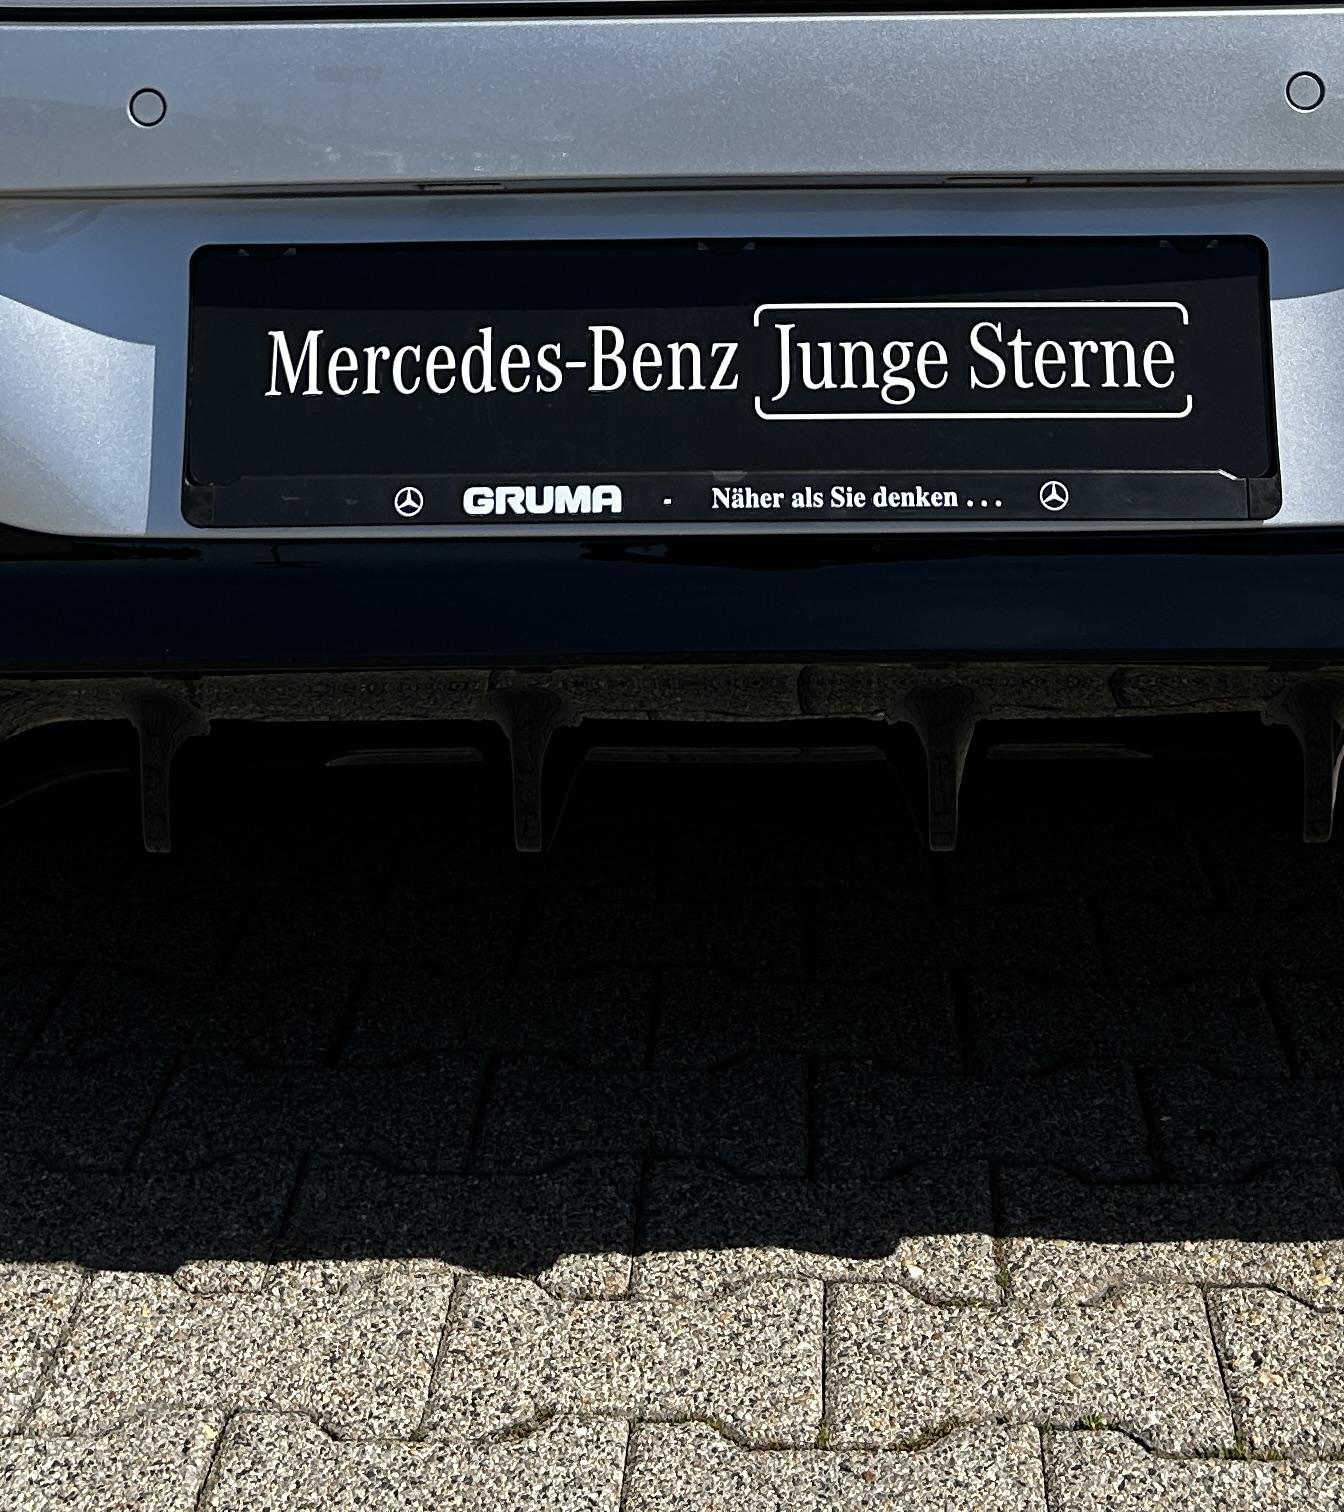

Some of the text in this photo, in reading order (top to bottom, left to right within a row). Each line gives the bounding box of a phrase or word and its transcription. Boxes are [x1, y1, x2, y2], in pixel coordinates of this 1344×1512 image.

[265, 320, 1175, 405] Mercedes-Benz Junge Sterne
[462, 484, 623, 515] GRUMA
[711, 486, 785, 510] Näher
[791, 486, 824, 509] als
[830, 485, 867, 508] Sie
[872, 485, 959, 508] denken
